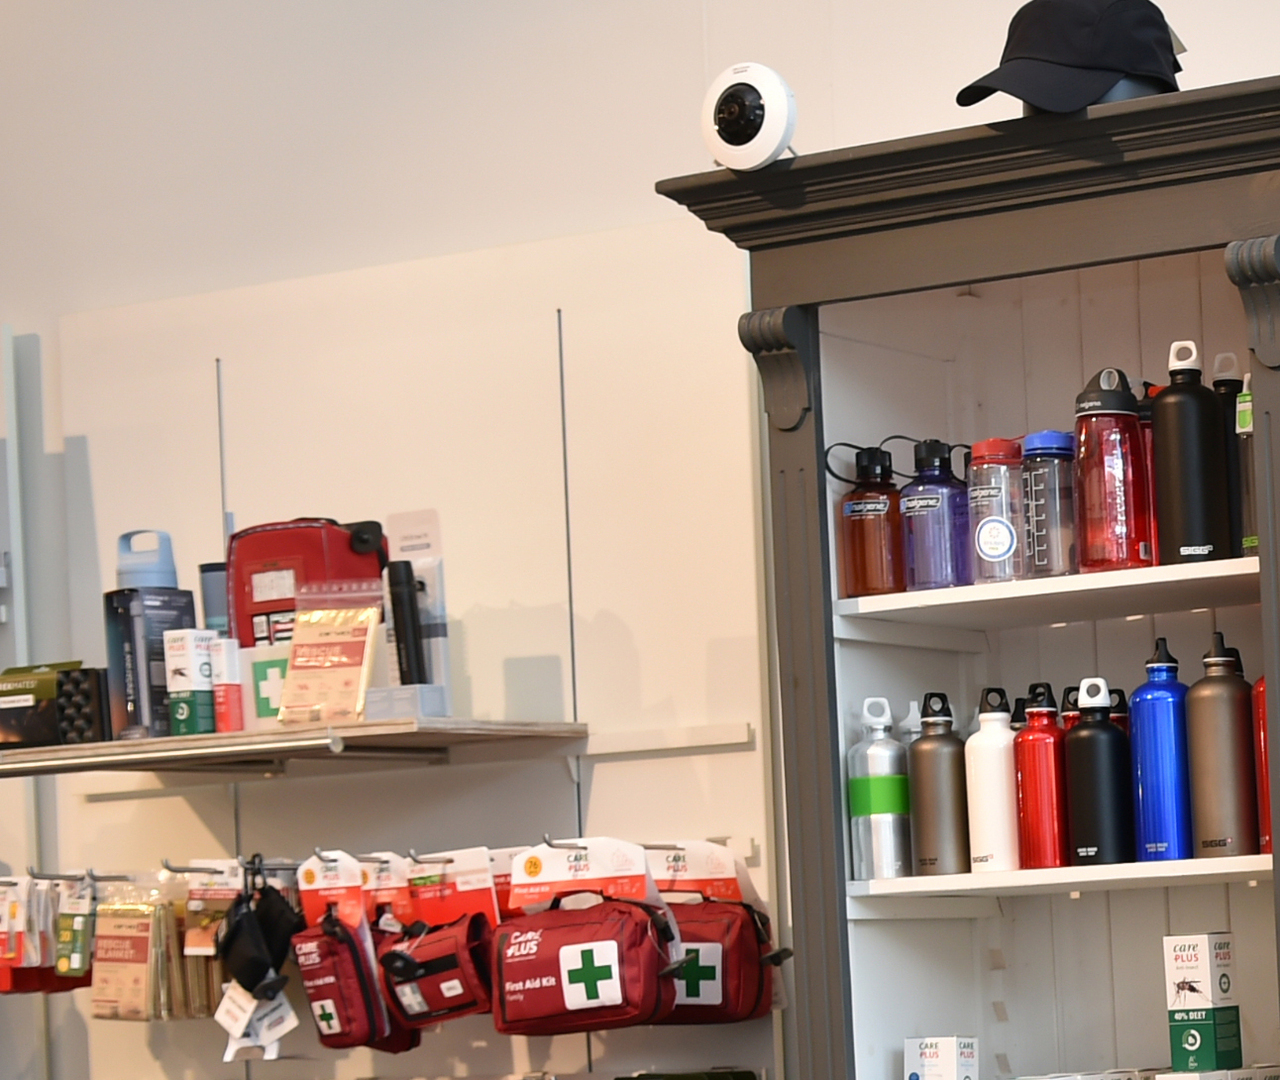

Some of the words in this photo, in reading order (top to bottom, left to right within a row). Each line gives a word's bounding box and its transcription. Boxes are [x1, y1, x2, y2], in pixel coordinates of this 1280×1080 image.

[1174, 954, 1199, 962] PLUS
[505, 981, 522, 992] First
[525, 979, 540, 990] Aid
[541, 976, 556, 987] Kit
[1174, 1012, 1187, 1020] 40%
[1188, 1011, 1206, 1020] DEET
